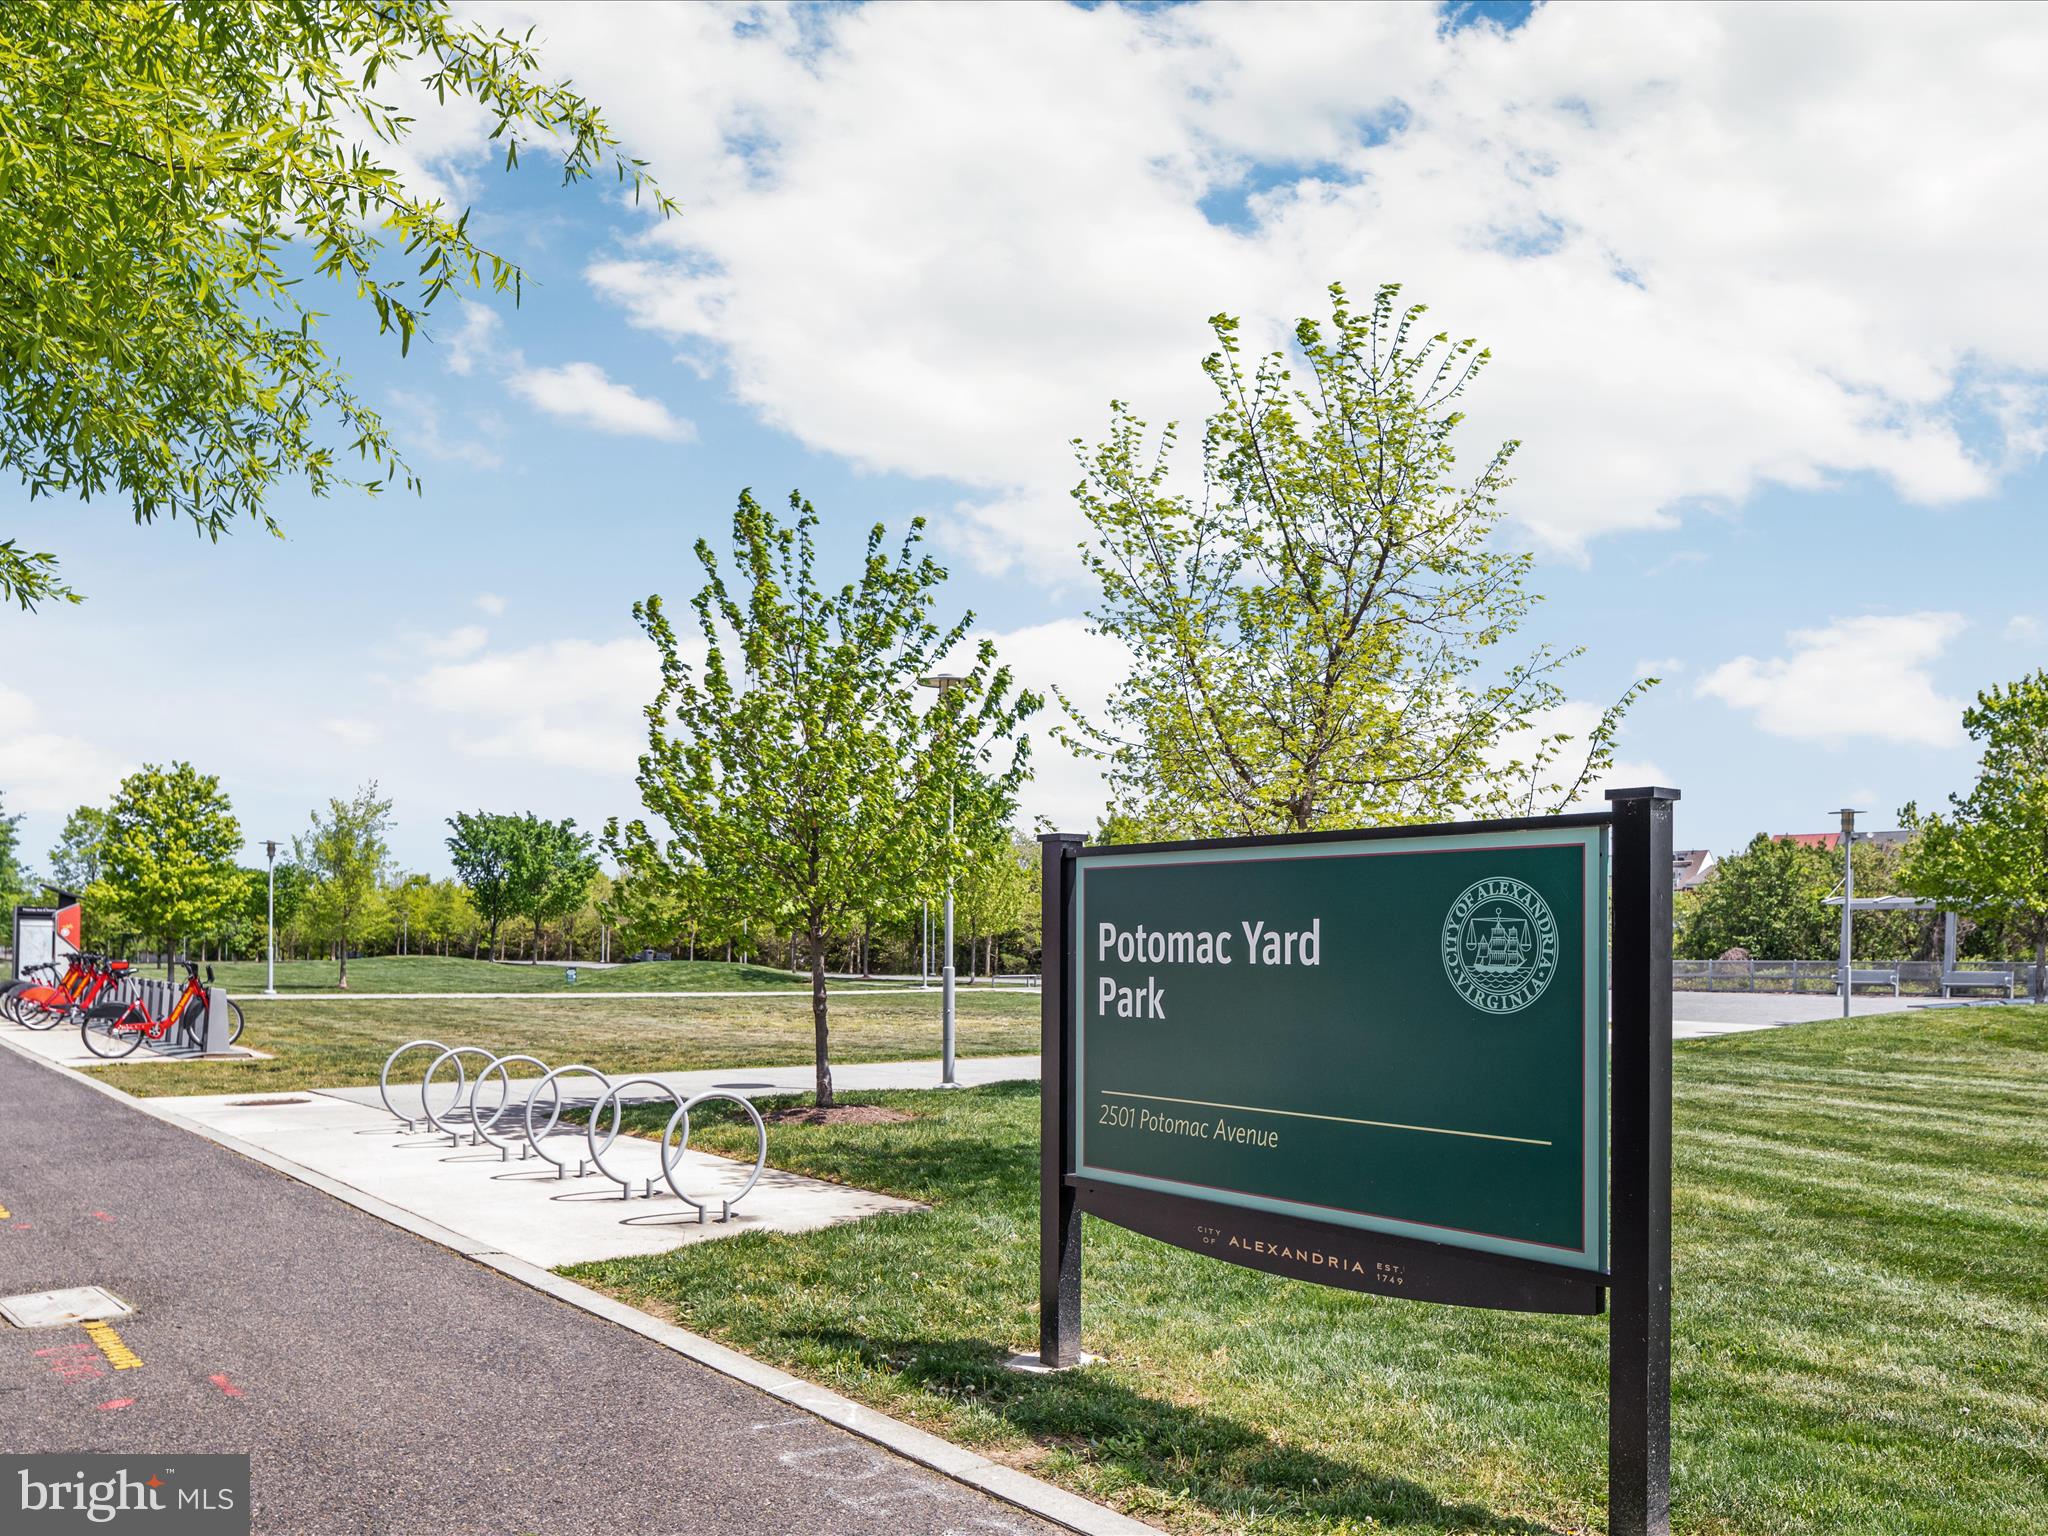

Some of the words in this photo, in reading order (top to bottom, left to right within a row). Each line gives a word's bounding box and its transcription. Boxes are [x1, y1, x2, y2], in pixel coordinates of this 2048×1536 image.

[1098, 922, 1232, 965] Potomac
[1242, 918, 1320, 966] Yard
[1445, 917, 1461, 967] CITY
[1455, 894, 1475, 918] OF
[1477, 881, 1554, 968] ALEXANDRIA
[1098, 976, 1166, 1020] Park
[1455, 972, 1545, 1010] VIRGINIA
[1099, 1104, 1135, 1128] 2501
[1140, 1109, 1208, 1139] Potomac
[1213, 1119, 1279, 1148] Avenue
[1197, 1225, 1221, 1237] CITY
[1202, 1236, 1216, 1245] OF
[1228, 1235, 1365, 1275] ALEXANDRIA
[1376, 1273, 1404, 1286] 1749
